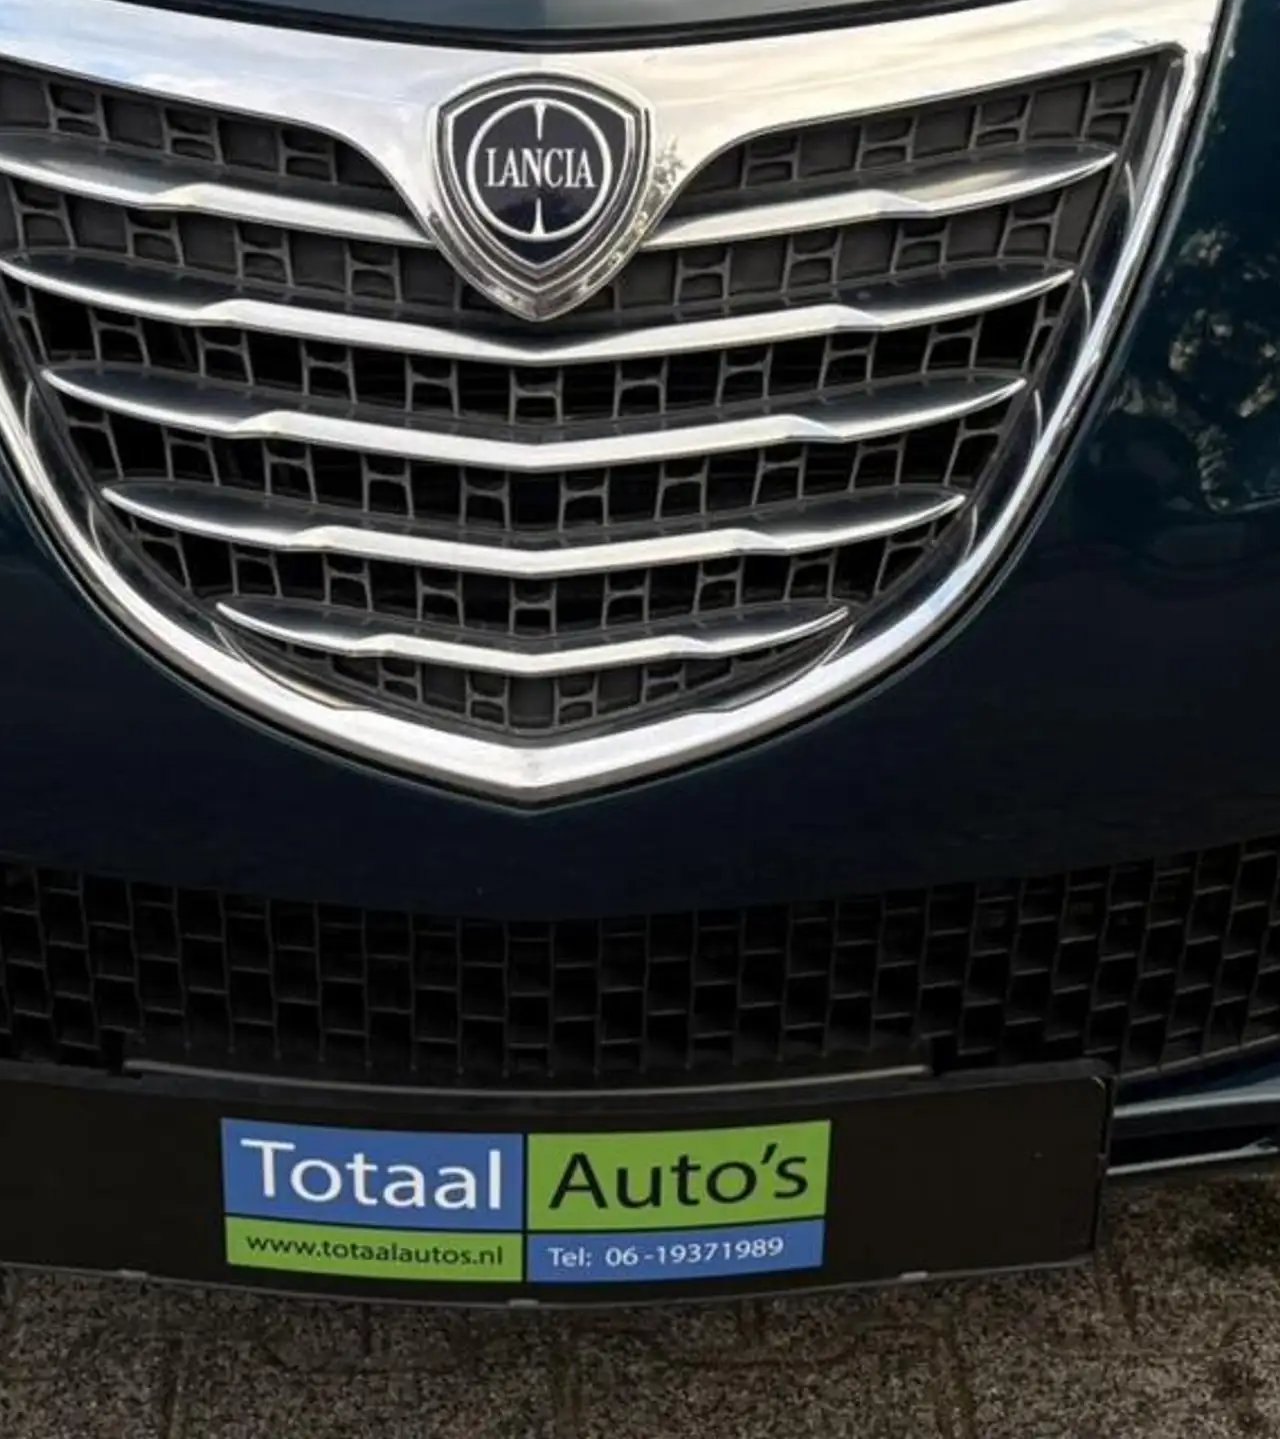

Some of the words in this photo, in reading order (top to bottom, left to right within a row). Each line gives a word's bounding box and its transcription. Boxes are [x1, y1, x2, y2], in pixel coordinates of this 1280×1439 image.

[485, 147, 596, 188] LANCIA
[240, 1137, 502, 1211] Totaal
[548, 1142, 809, 1210] Auto's
[246, 1235, 504, 1266] www.totaalautos.nl
[547, 1246, 592, 1267] Tel:
